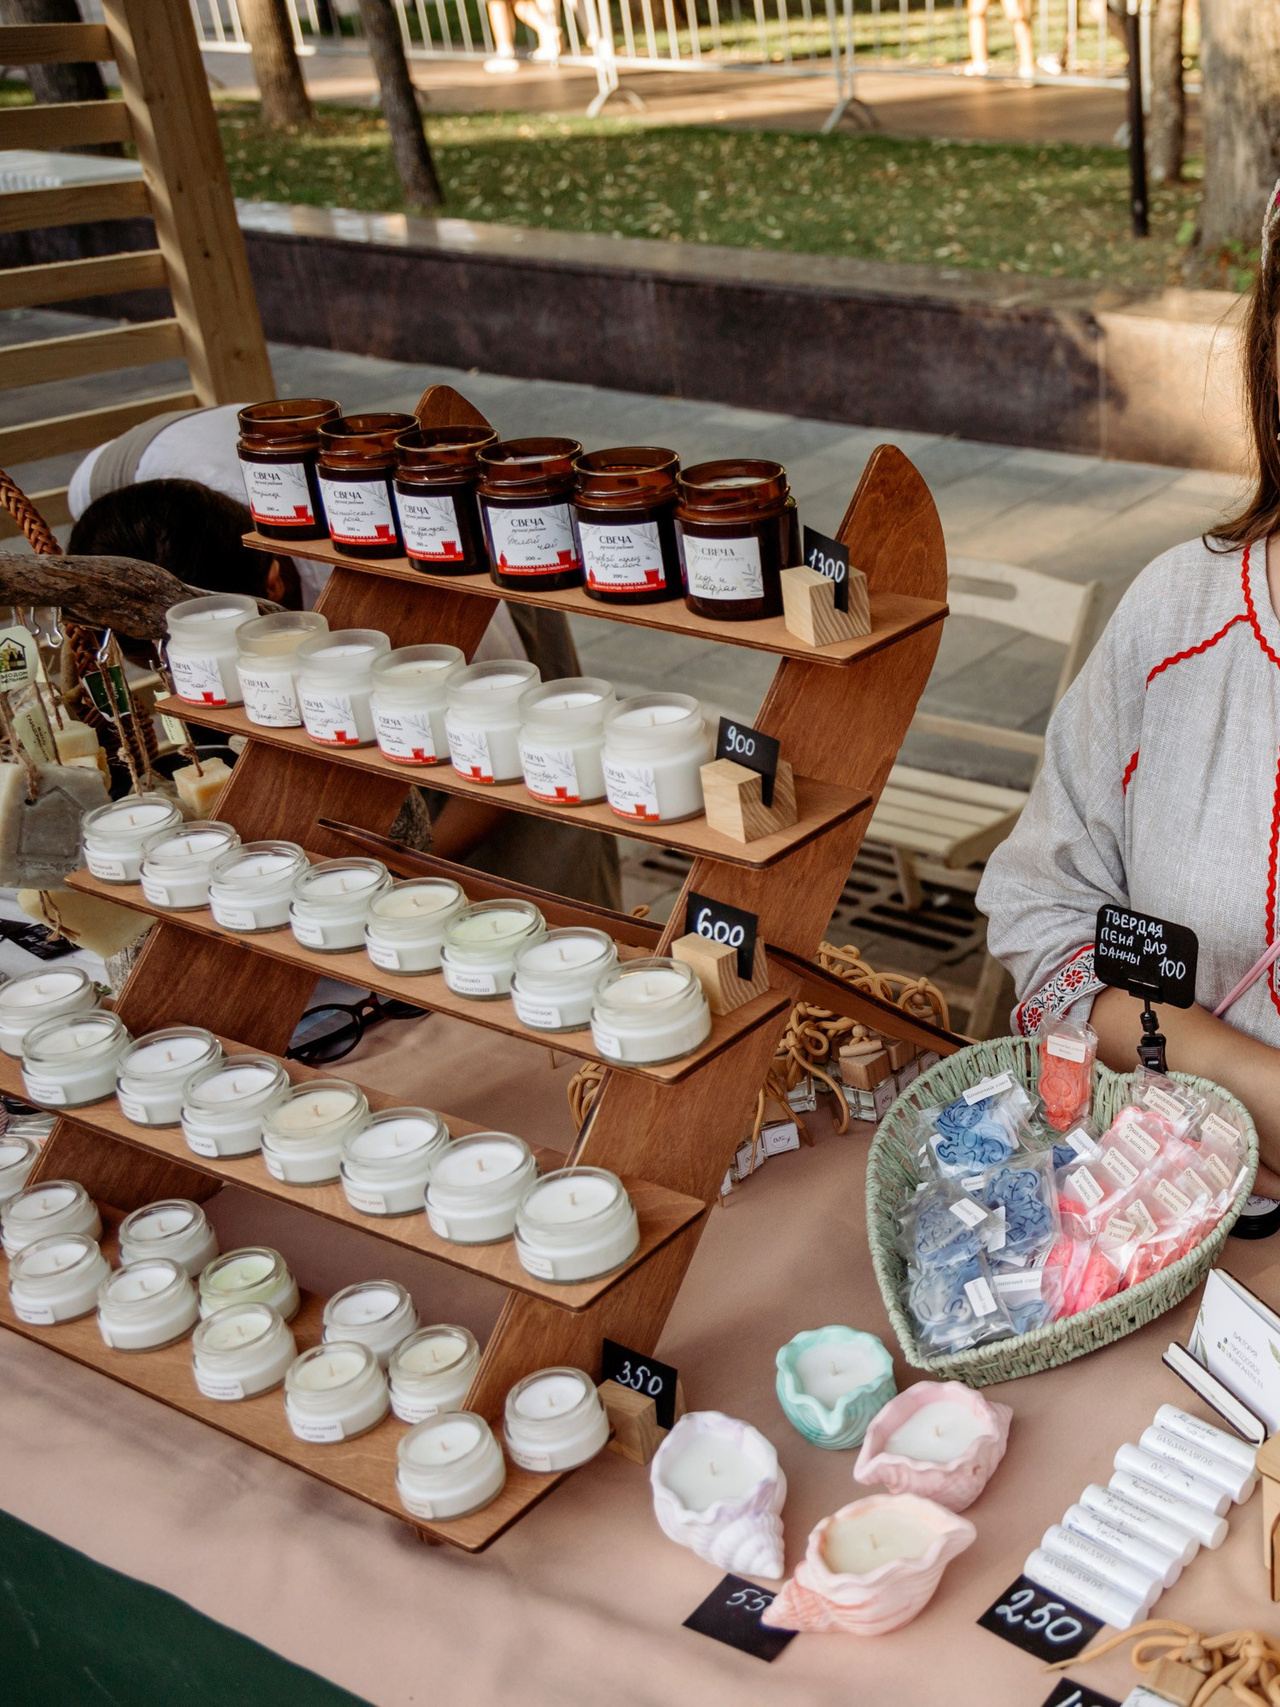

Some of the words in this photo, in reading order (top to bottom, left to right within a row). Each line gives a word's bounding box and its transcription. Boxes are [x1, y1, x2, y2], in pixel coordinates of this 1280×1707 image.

[253, 471, 281, 481] СВЕЧА
[333, 490, 362, 500] СВЕЧА
[404, 504, 430, 515] СВЕЧА
[510, 517, 545, 528] СВЕЧА
[598, 535, 633, 545] СВЕЧА
[701, 547, 736, 557] СВЕЧА
[809, 548, 846, 583] 1300
[726, 725, 756, 757] 900
[697, 907, 745, 947] 600
[1105, 908, 1164, 939] ТВЕРДАЯ
[1100, 926, 1135, 948] ПЕНА
[1142, 938, 1168, 956] ДЛЯ
[1099, 942, 1141, 967] ВАННЫ
[1158, 956, 1187, 981] 100
[615, 1360, 664, 1396] 350
[725, 1587, 772, 1612] 55
[995, 1588, 1083, 1645] 250
